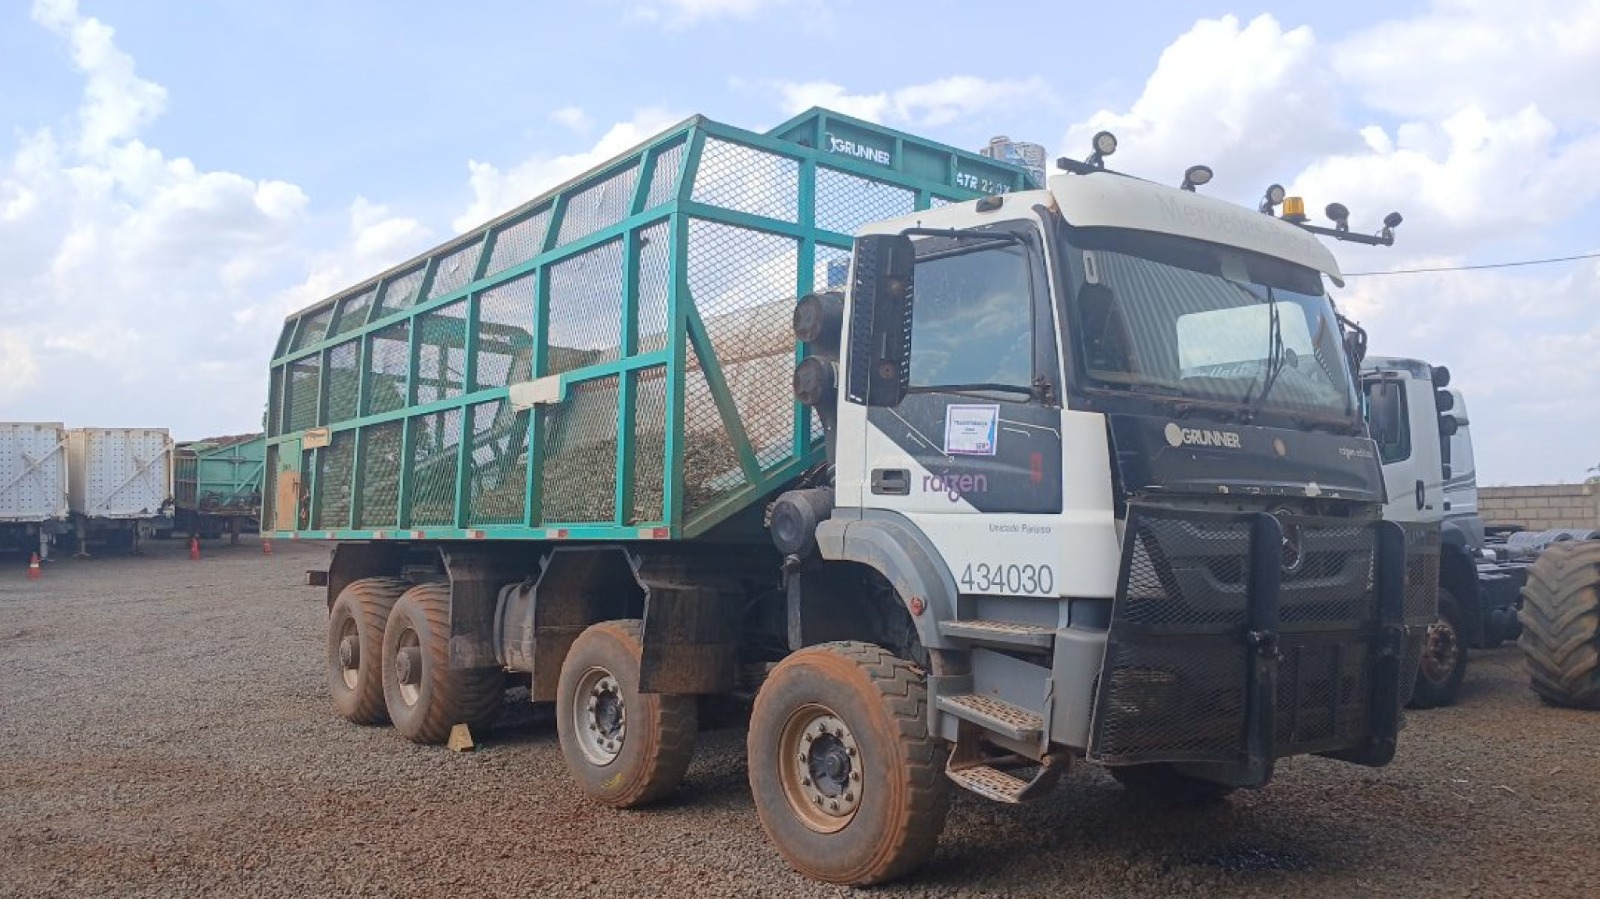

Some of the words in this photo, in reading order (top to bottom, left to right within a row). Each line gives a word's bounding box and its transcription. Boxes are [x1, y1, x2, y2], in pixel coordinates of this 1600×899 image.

[836, 137, 890, 166] GRUNNER
[1181, 427, 1241, 448] GRUNNER
[961, 563, 1053, 595] 434030
